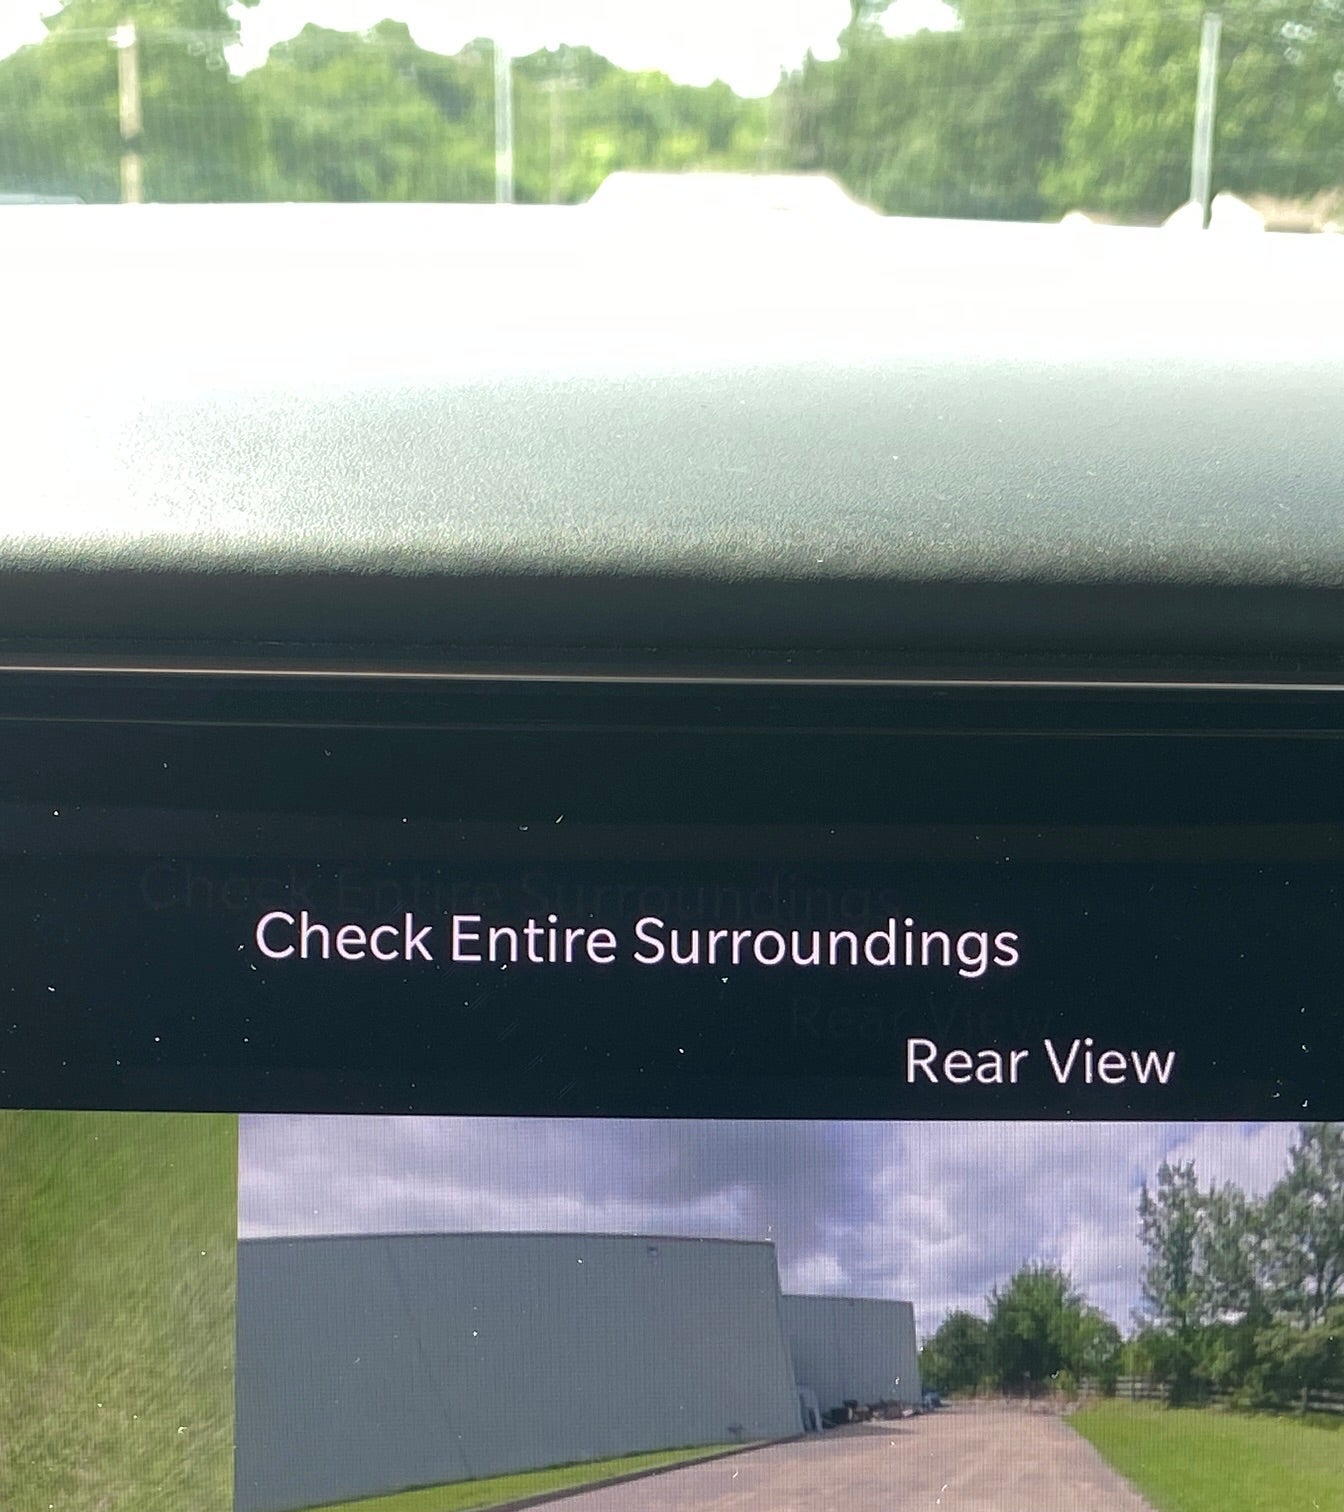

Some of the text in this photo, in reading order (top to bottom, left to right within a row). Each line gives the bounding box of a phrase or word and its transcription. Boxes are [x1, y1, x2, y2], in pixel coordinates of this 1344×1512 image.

[257, 911, 1018, 978] Check Entire Surroundings
[908, 1038, 1175, 1083] Rear View
